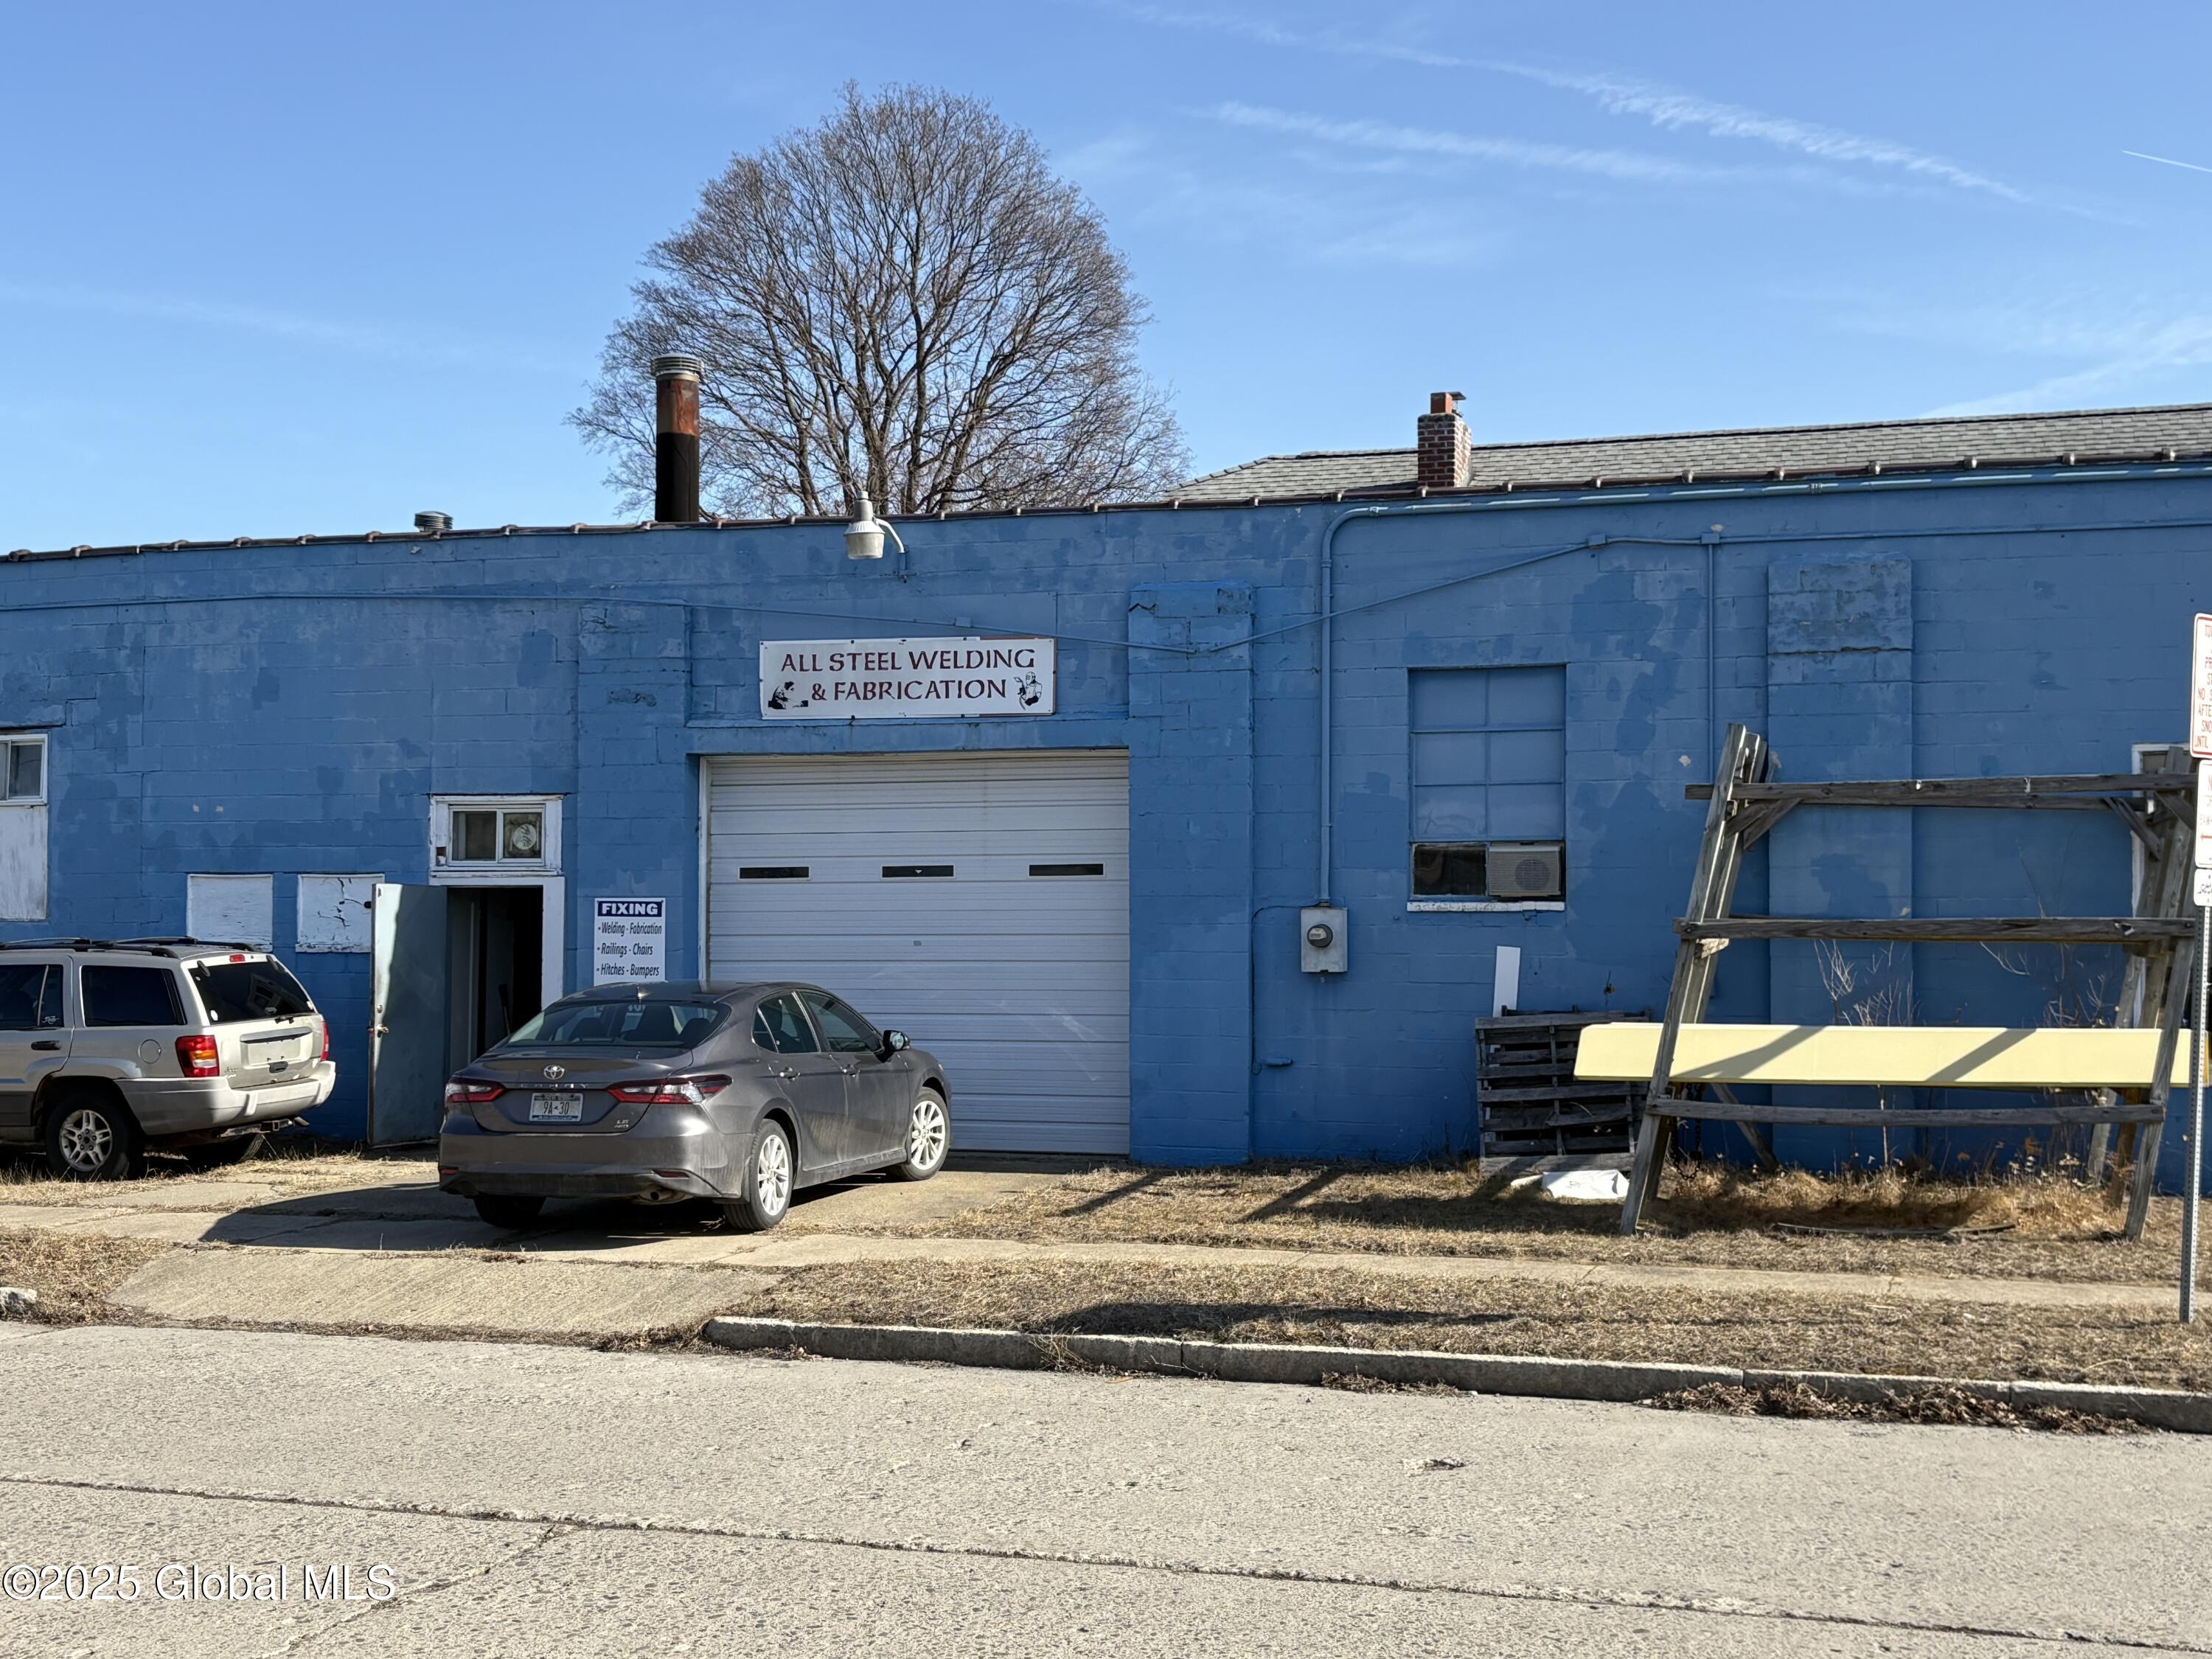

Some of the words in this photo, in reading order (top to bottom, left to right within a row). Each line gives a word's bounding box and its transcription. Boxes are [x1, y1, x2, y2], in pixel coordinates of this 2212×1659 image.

[781, 653, 824, 672] ALL
[829, 652, 902, 672] STEEL
[908, 648, 1035, 670] WELDING
[812, 682, 828, 701] &
[833, 679, 1007, 701] FABRICATION
[602, 902, 658, 915] FIXING
[601, 921, 625, 937] Welding
[630, 922, 662, 935] Fabrication
[601, 942, 627, 958] Railings
[633, 942, 653, 956] Chairs
[600, 962, 625, 975] Hitches
[630, 964, 660, 978] Bumpers
